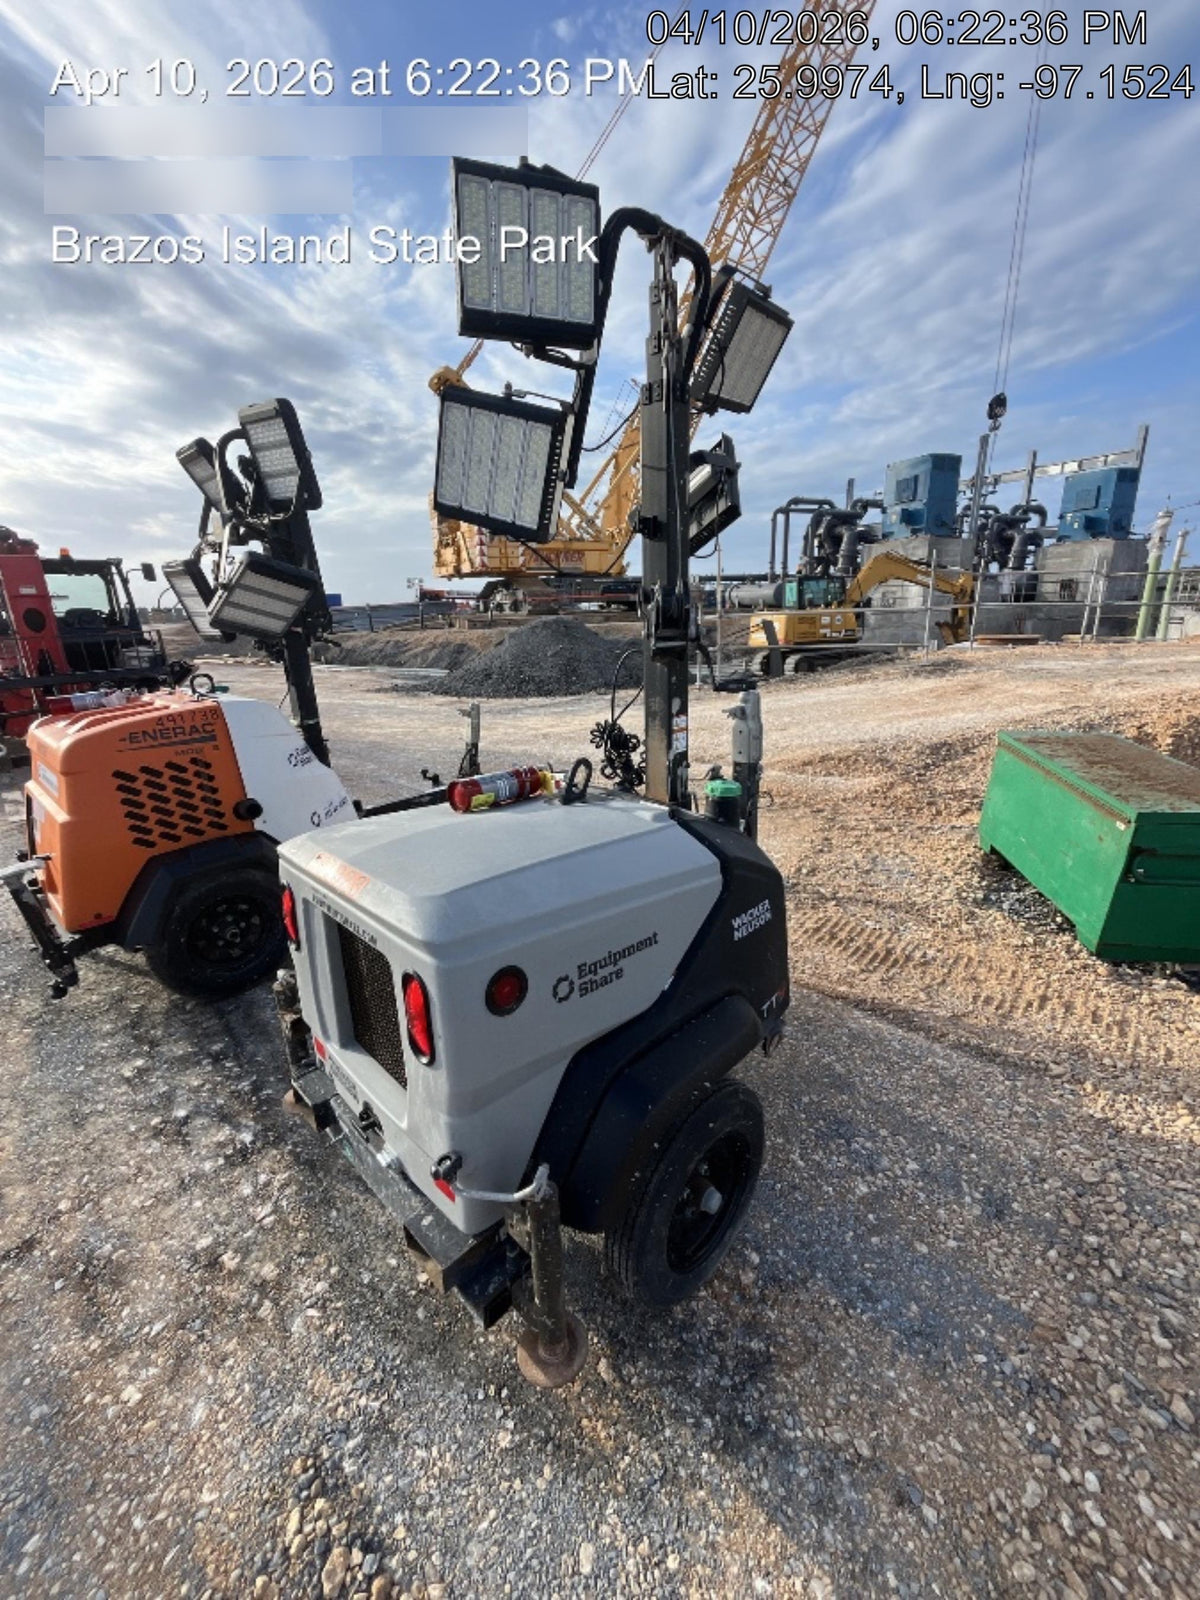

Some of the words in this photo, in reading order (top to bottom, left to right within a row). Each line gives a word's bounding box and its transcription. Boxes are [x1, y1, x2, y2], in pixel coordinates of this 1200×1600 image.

[118, 722, 216, 745] ENERAC
[731, 899, 771, 929] WACKER
[733, 910, 773, 941] NEUSON
[577, 931, 659, 980] Equipment
[578, 966, 624, 999] Share
